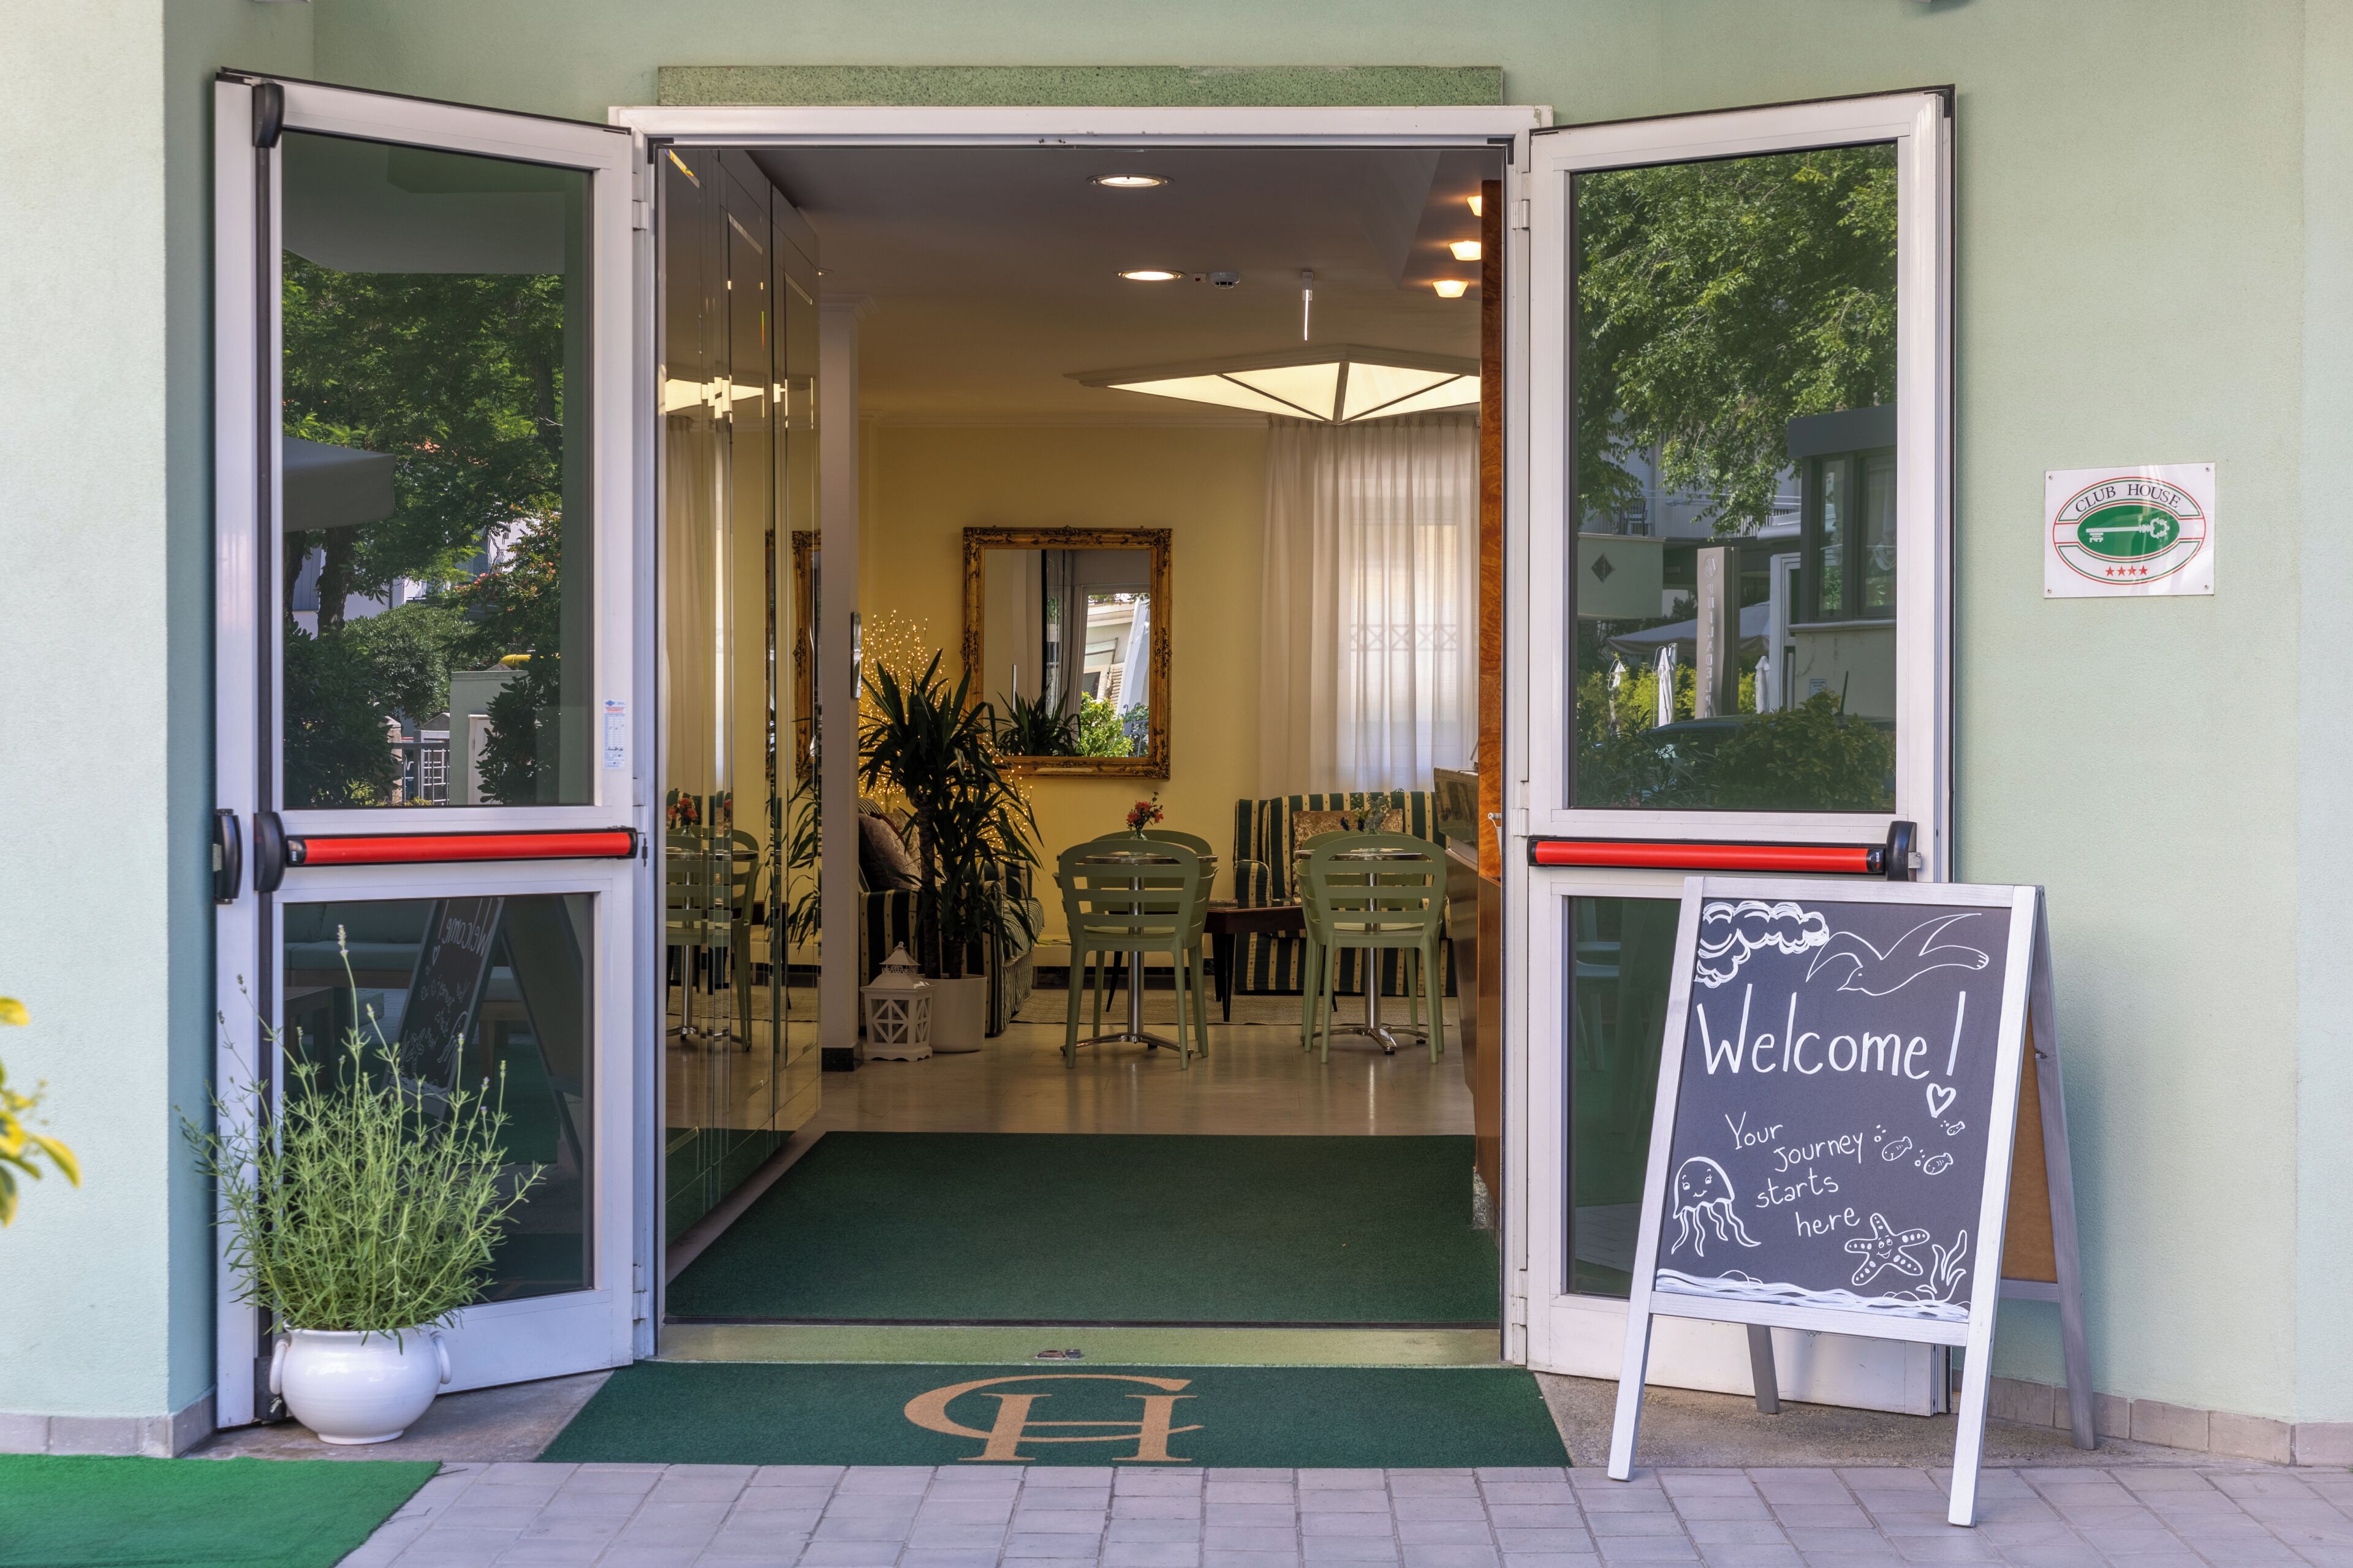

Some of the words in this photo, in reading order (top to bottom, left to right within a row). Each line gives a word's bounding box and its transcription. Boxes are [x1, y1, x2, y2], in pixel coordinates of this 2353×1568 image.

[2075, 485, 2116, 513] CLUB
[2127, 483, 2181, 509] HOUSE
[1725, 1111, 1783, 1150] Your
[1756, 1167, 1839, 1208] starts
[1795, 1207, 1861, 1237] here
